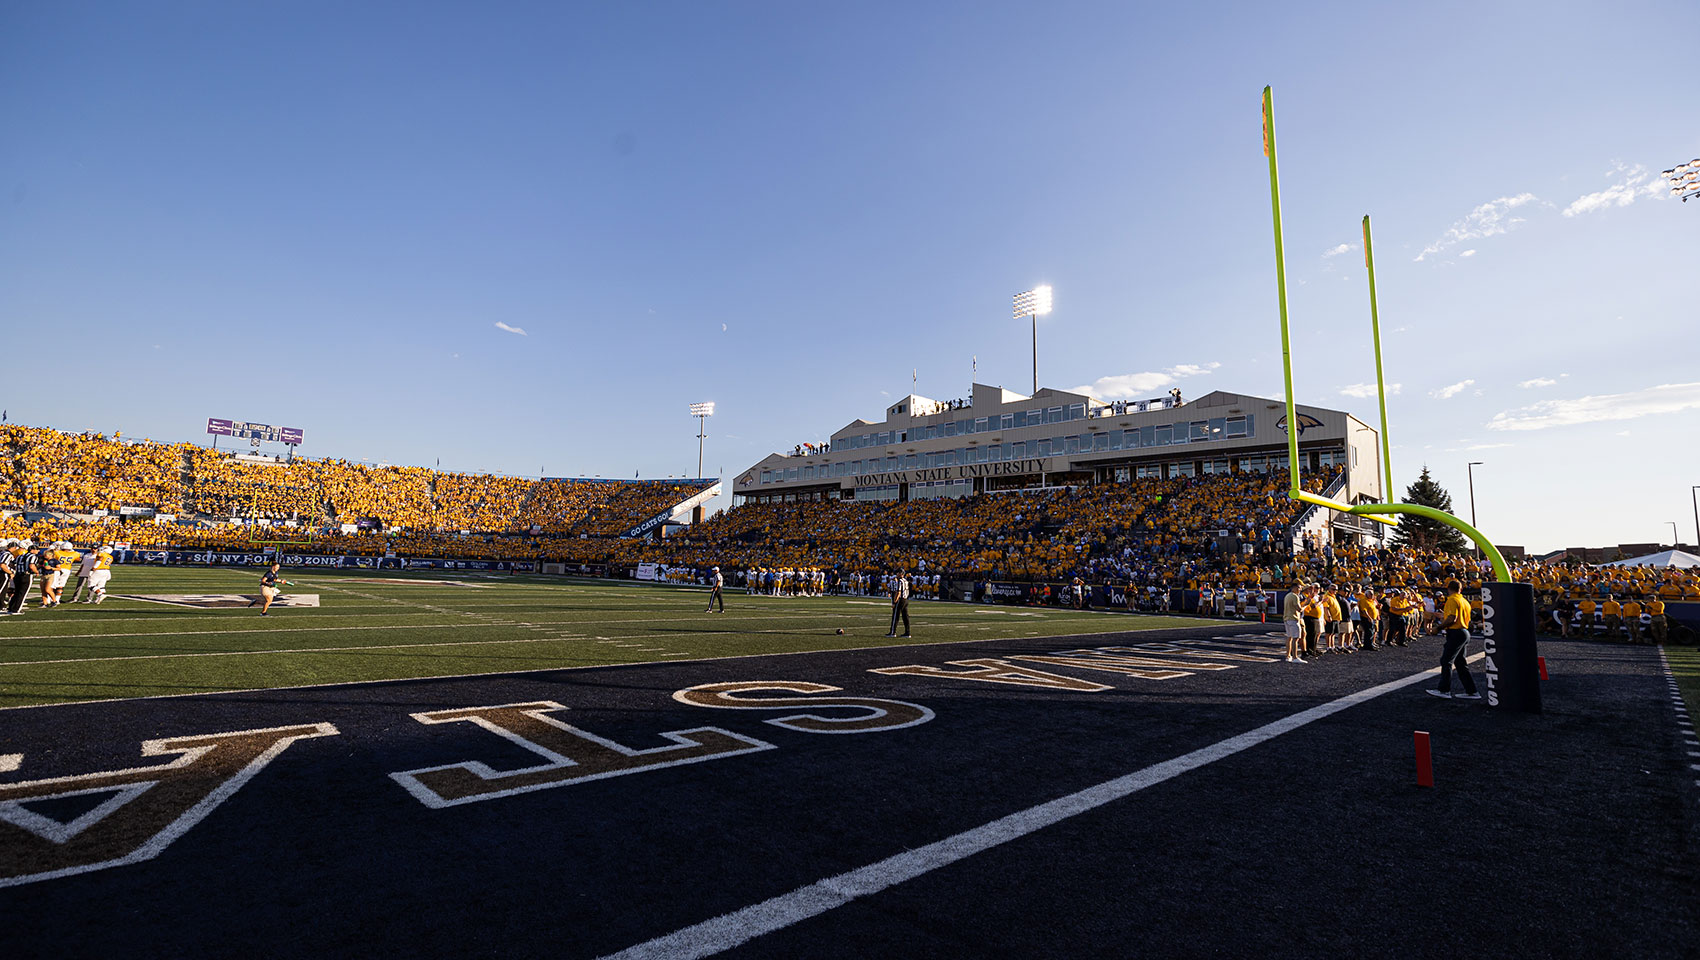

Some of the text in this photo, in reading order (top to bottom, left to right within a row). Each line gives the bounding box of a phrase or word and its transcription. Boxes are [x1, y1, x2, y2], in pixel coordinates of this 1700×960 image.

[854, 458, 1047, 487] MONTANA STATE UNIVERSITY
[630, 527, 641, 537] GO
[641, 518, 658, 531] CATS
[59, 556, 74, 565] 55
[305, 557, 337, 565] ZONE
[1481, 587, 1499, 706] BOBCATS
